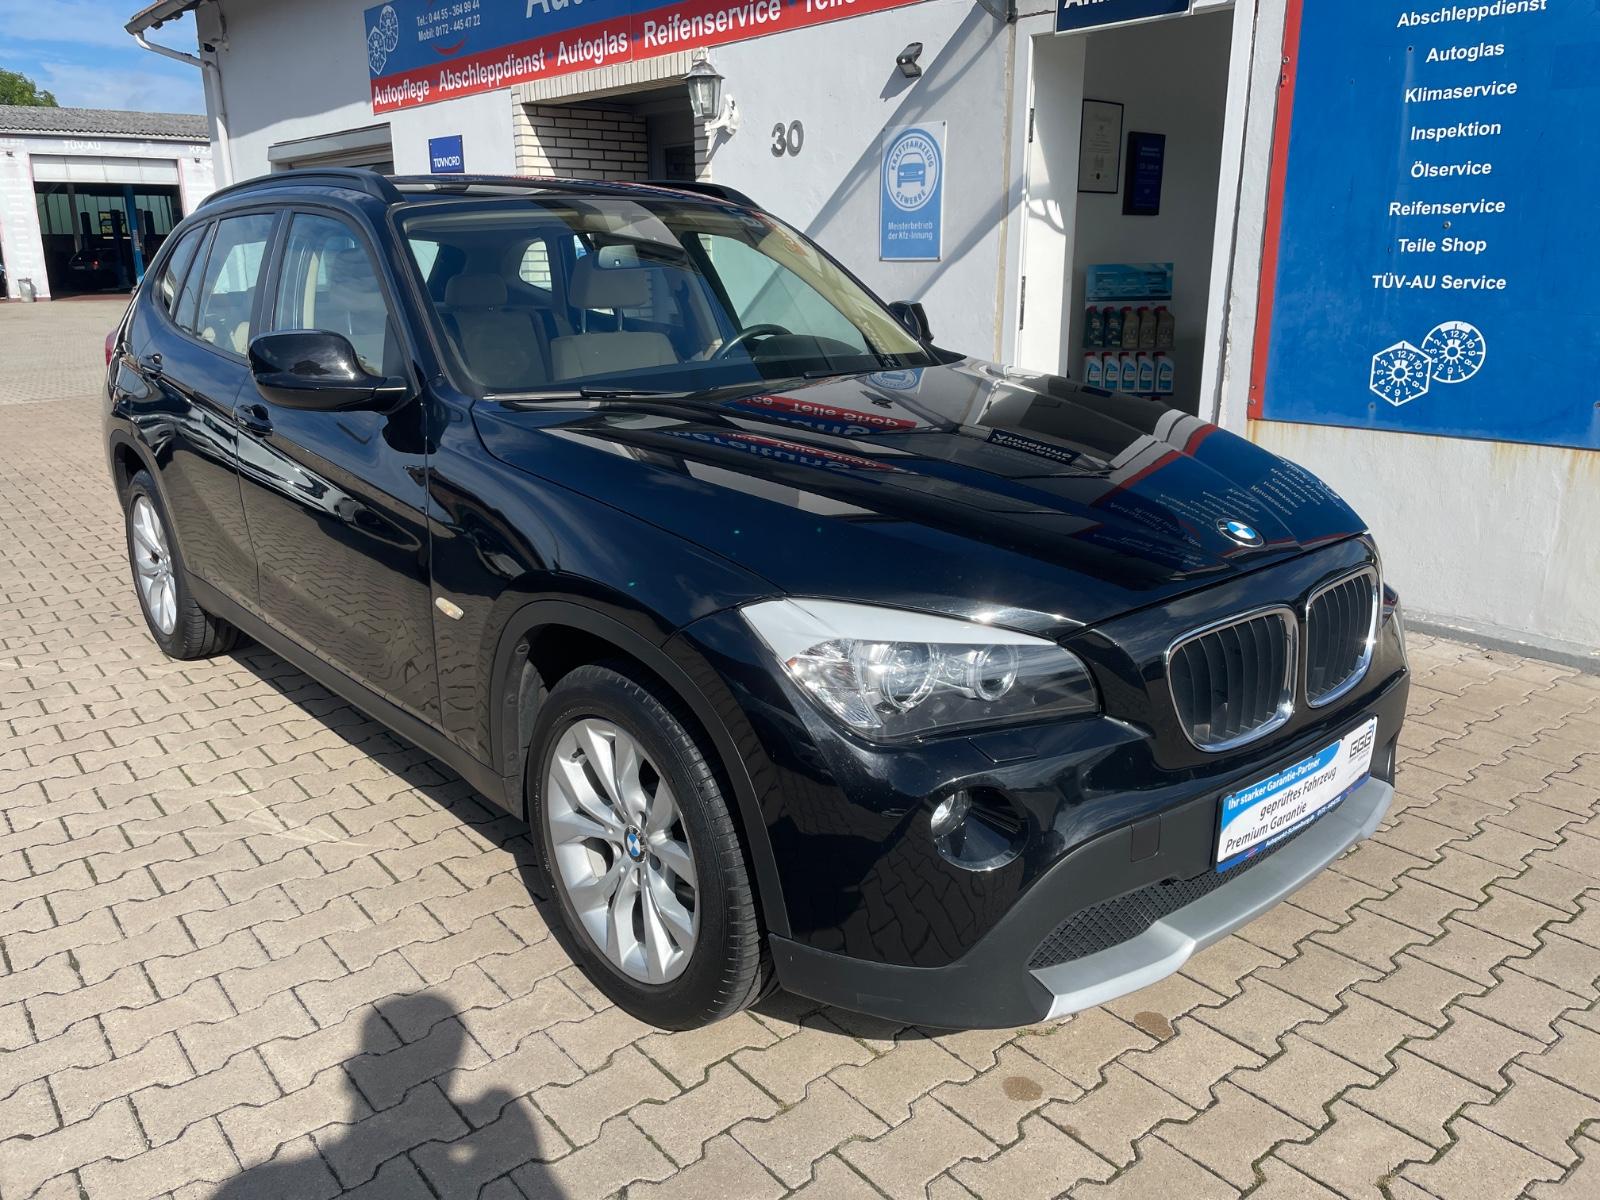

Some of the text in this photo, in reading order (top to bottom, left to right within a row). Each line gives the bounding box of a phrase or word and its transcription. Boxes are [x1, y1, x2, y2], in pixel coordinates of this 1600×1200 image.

[441, 8, 448, 20] 55
[473, 14, 481, 26] 22
[1397, 0, 1547, 27] Abschleppdienst
[374, 0, 781, 107] Autopflege Abschleppdienst Autoglas Reifenservice
[1425, 42, 1505, 63] Autoglas
[1404, 81, 1518, 103] Klimaservice
[770, 119, 804, 157] 30
[1410, 121, 1501, 142] Inspektion
[891, 140, 934, 171] KRAFTFAHRZEUG
[1411, 160, 1492, 178] Ölservice
[896, 190, 926, 205] GEWERBE
[1389, 199, 1506, 216] Reifenservice
[888, 221, 933, 231] Meisterbetrieb
[888, 231, 898, 240] der
[1398, 237, 1487, 255] Teile Shop
[1372, 272, 1507, 290] TÜV-AU Service
[1228, 758, 1321, 810] Ihr starker Garantie-Partner
[1260, 788, 1302, 821] geprüftes
[1303, 766, 1337, 797] Fahrzeug
[1225, 823, 1268, 853] Premium
[1270, 802, 1307, 830] Garantie
